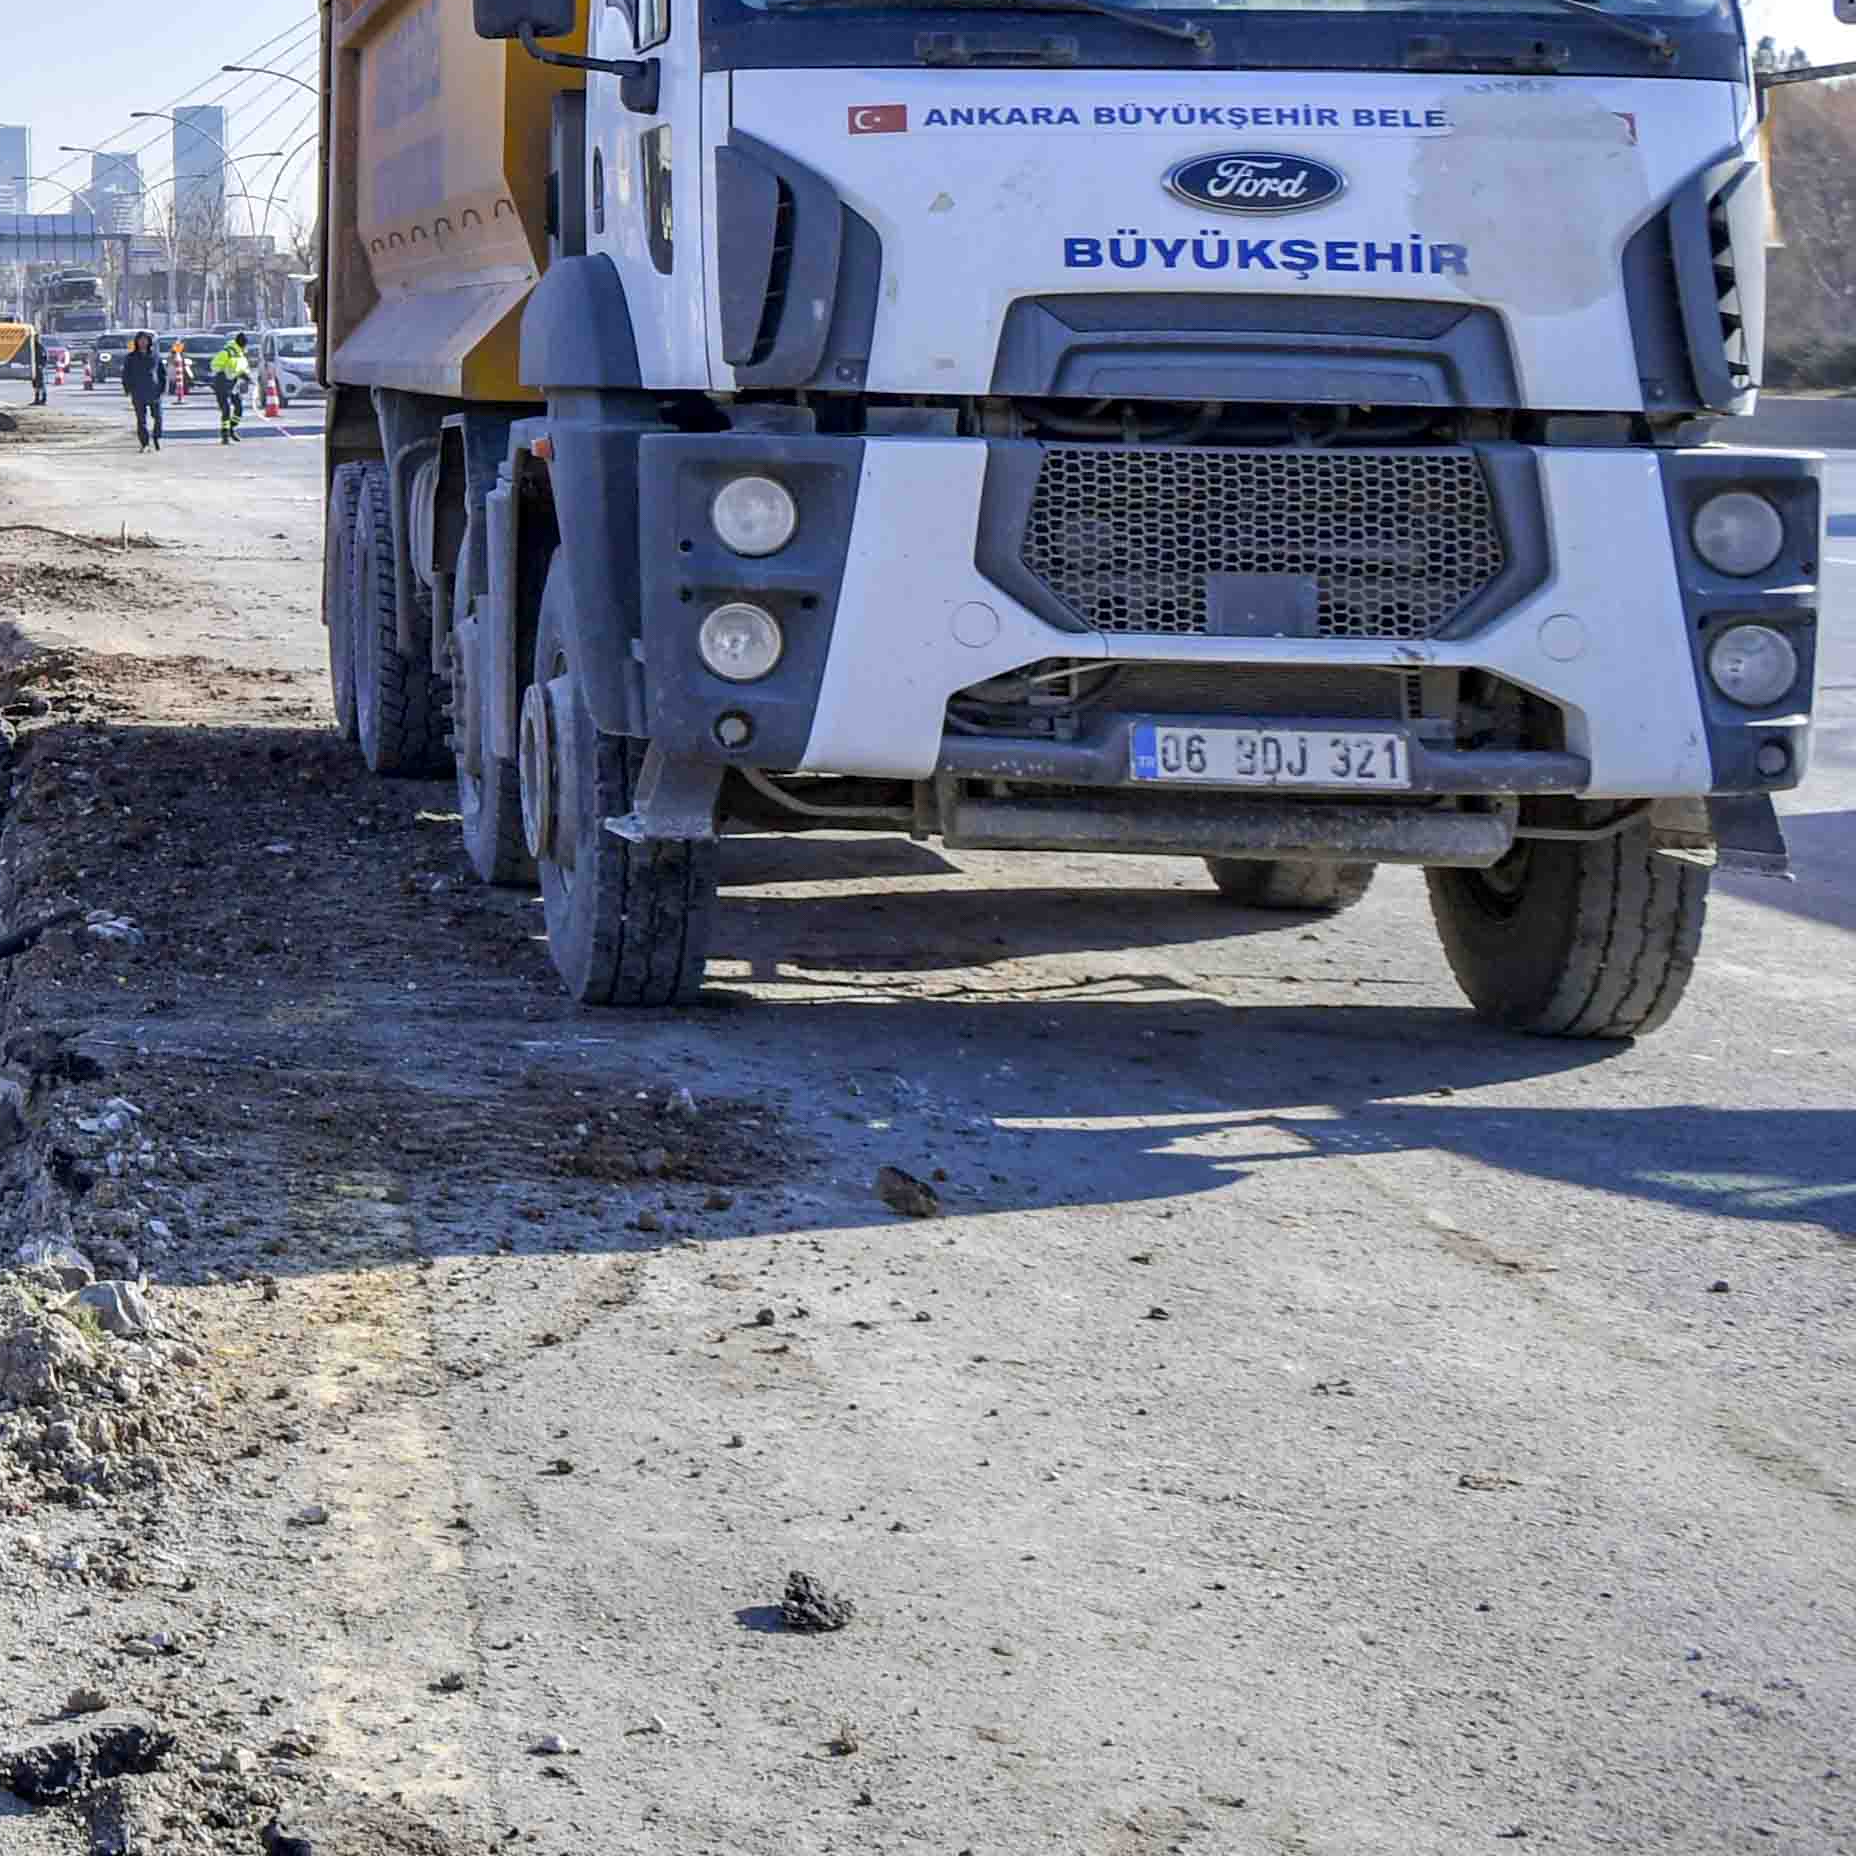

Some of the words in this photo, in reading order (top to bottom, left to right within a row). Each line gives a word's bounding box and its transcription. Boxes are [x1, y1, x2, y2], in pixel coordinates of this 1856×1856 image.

[923, 106, 1081, 127] ANKARA
[1093, 102, 1340, 131] BÜYÜKŞEHİR
[1351, 107, 1449, 128] BELE
[1207, 159, 1307, 199] Ford
[1062, 228, 1470, 280] BÜYÜKŞEHİR
[1161, 735, 1207, 774] 06
[1329, 737, 1400, 780] 321
